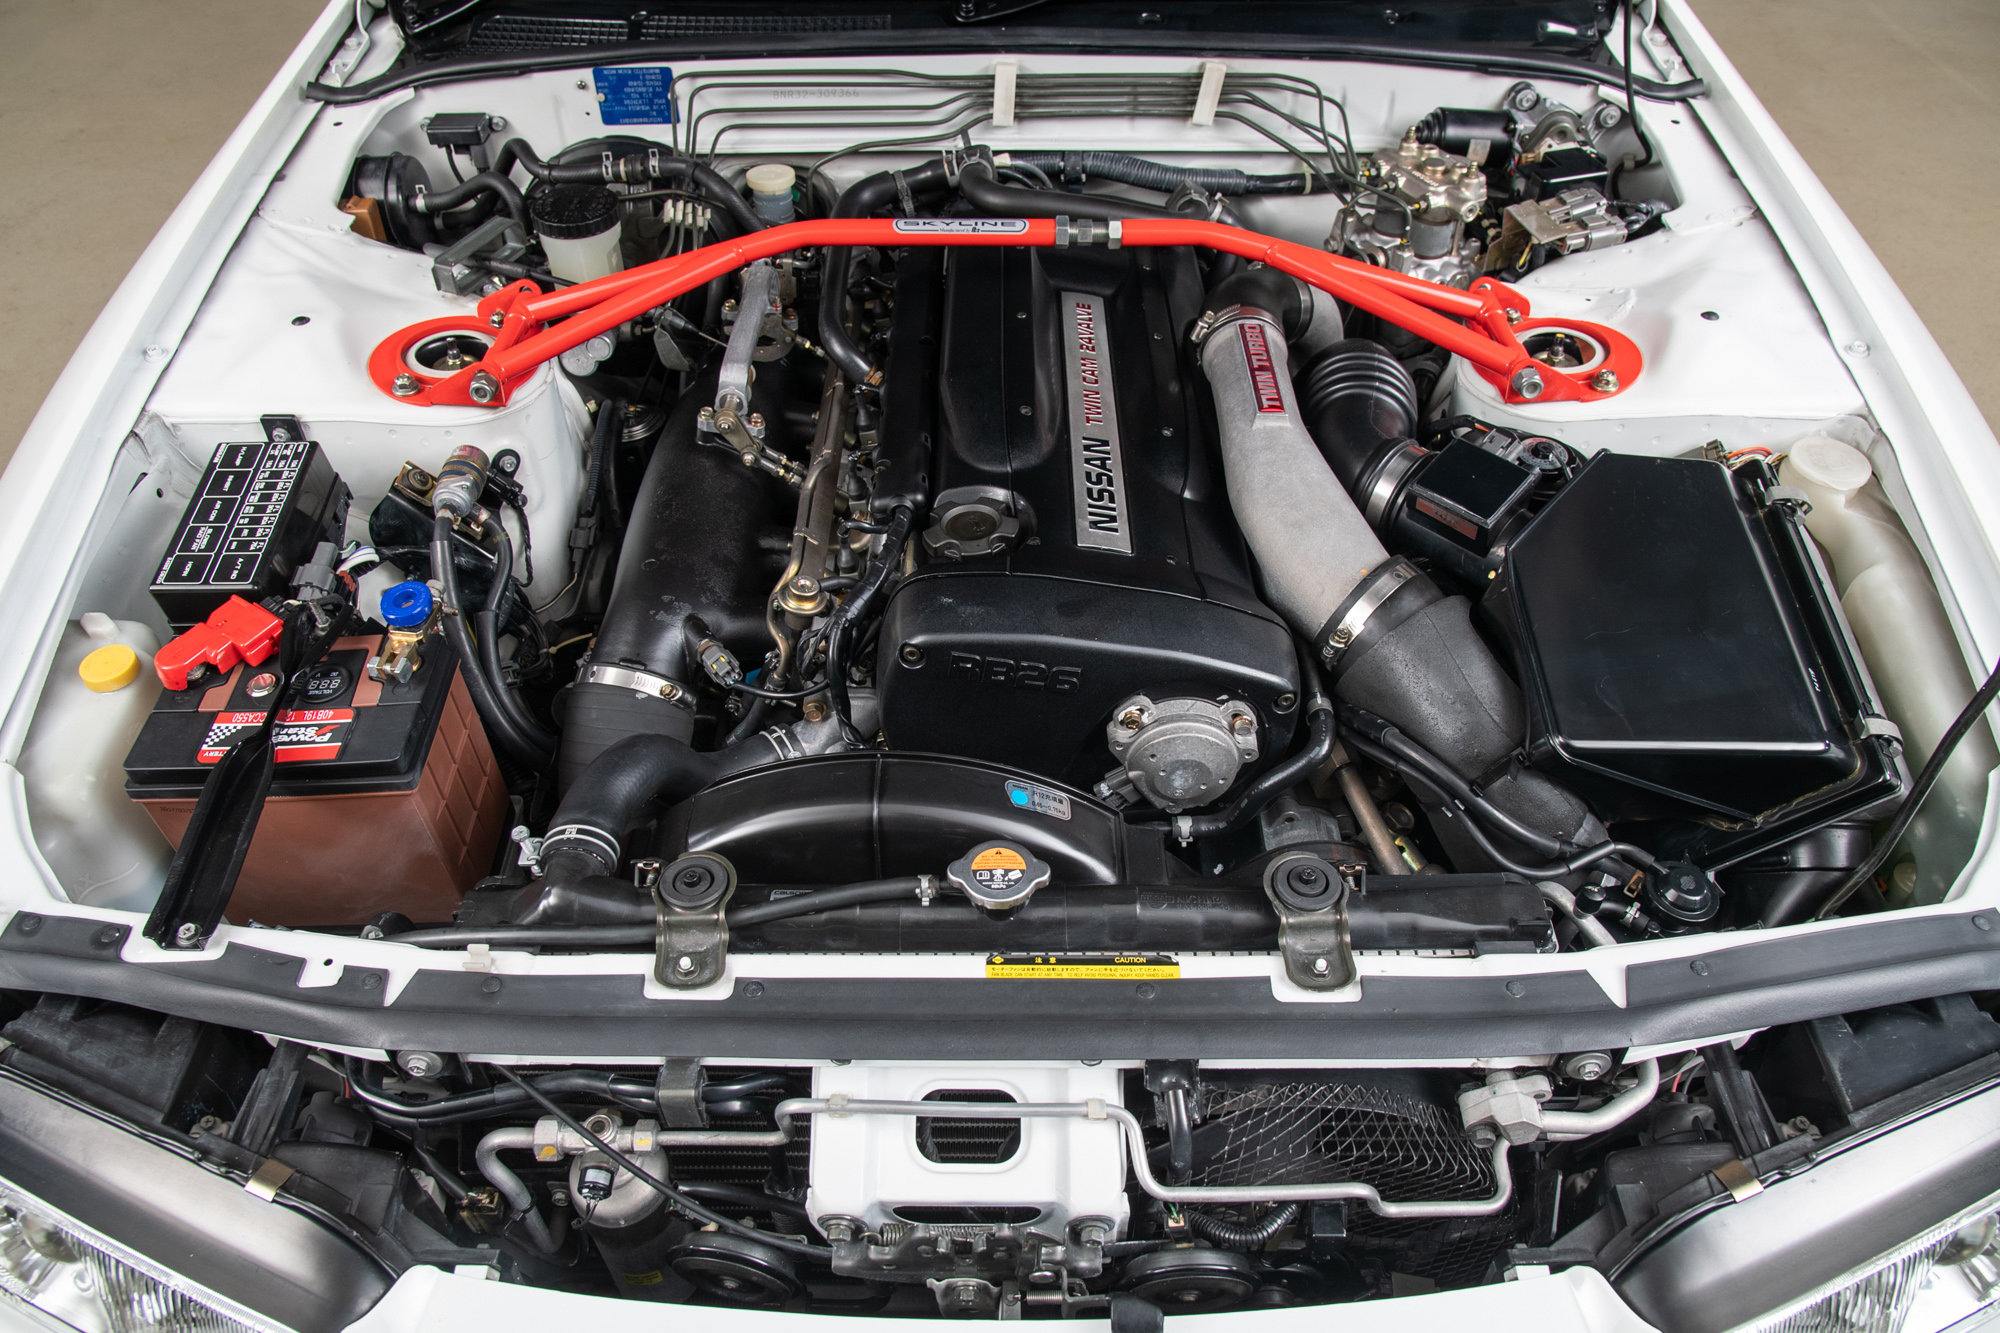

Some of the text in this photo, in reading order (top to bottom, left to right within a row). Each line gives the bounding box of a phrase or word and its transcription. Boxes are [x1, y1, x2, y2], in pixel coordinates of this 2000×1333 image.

[773, 88, 860, 99] BNR32-309366
[1244, 324, 1280, 408] TWIN TURBO
[1076, 302, 1119, 533] NISSAN TWIN CAM 24VALVE
[182, 561, 194, 577] HORN
[948, 651, 1082, 693] RB26
[304, 710, 334, 720] 40B19L
